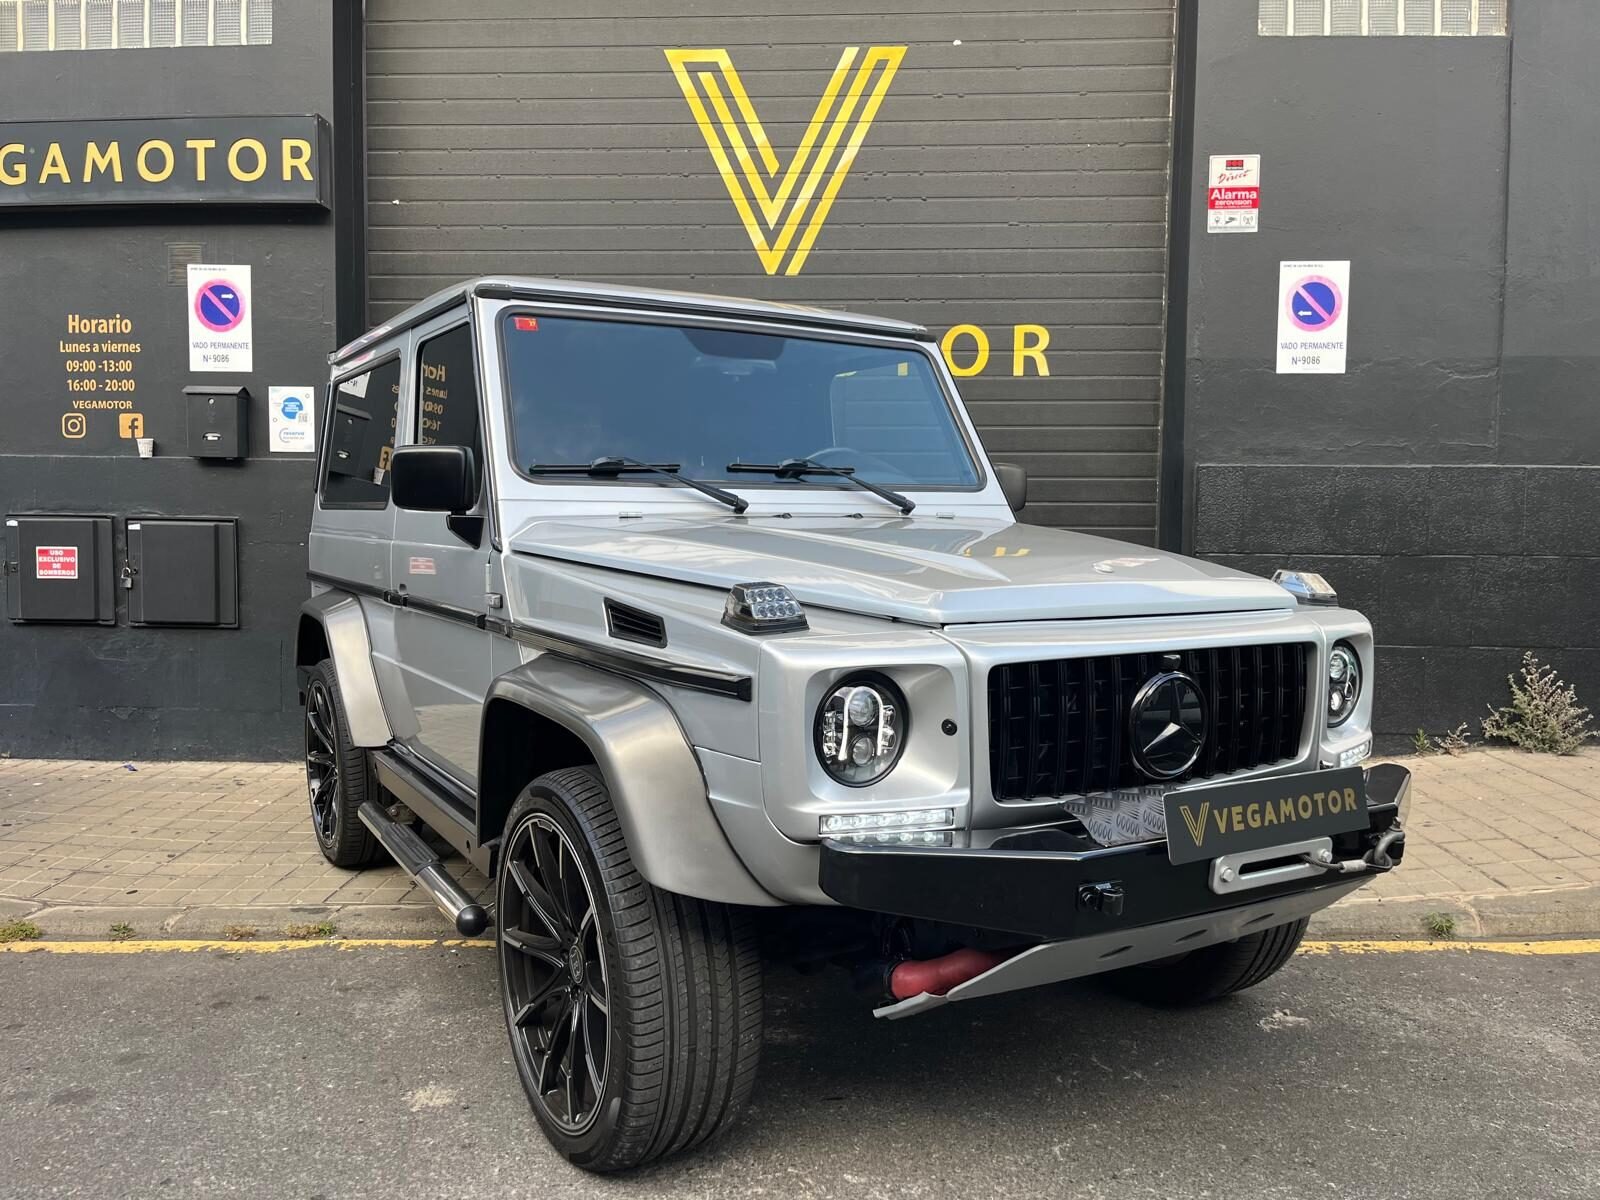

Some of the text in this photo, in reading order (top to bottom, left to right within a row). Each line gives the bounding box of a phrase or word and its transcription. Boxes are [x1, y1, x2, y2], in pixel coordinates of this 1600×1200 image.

[0, 138, 314, 186] GAMOTOR
[1210, 188, 1257, 200] Alarma
[68, 313, 132, 334] Horario
[59, 340, 142, 353] Lunes a viernes
[192, 341, 250, 350] VADO PERMANENTE
[1280, 342, 1344, 350] VADO PERMANENTE
[66, 359, 97, 372] 09:00
[66, 379, 97, 392] 16:00
[104, 379, 136, 392] 20:00
[72, 400, 133, 409] VEGAMOTOR
[1213, 787, 1358, 834] VEGAMOTOR
